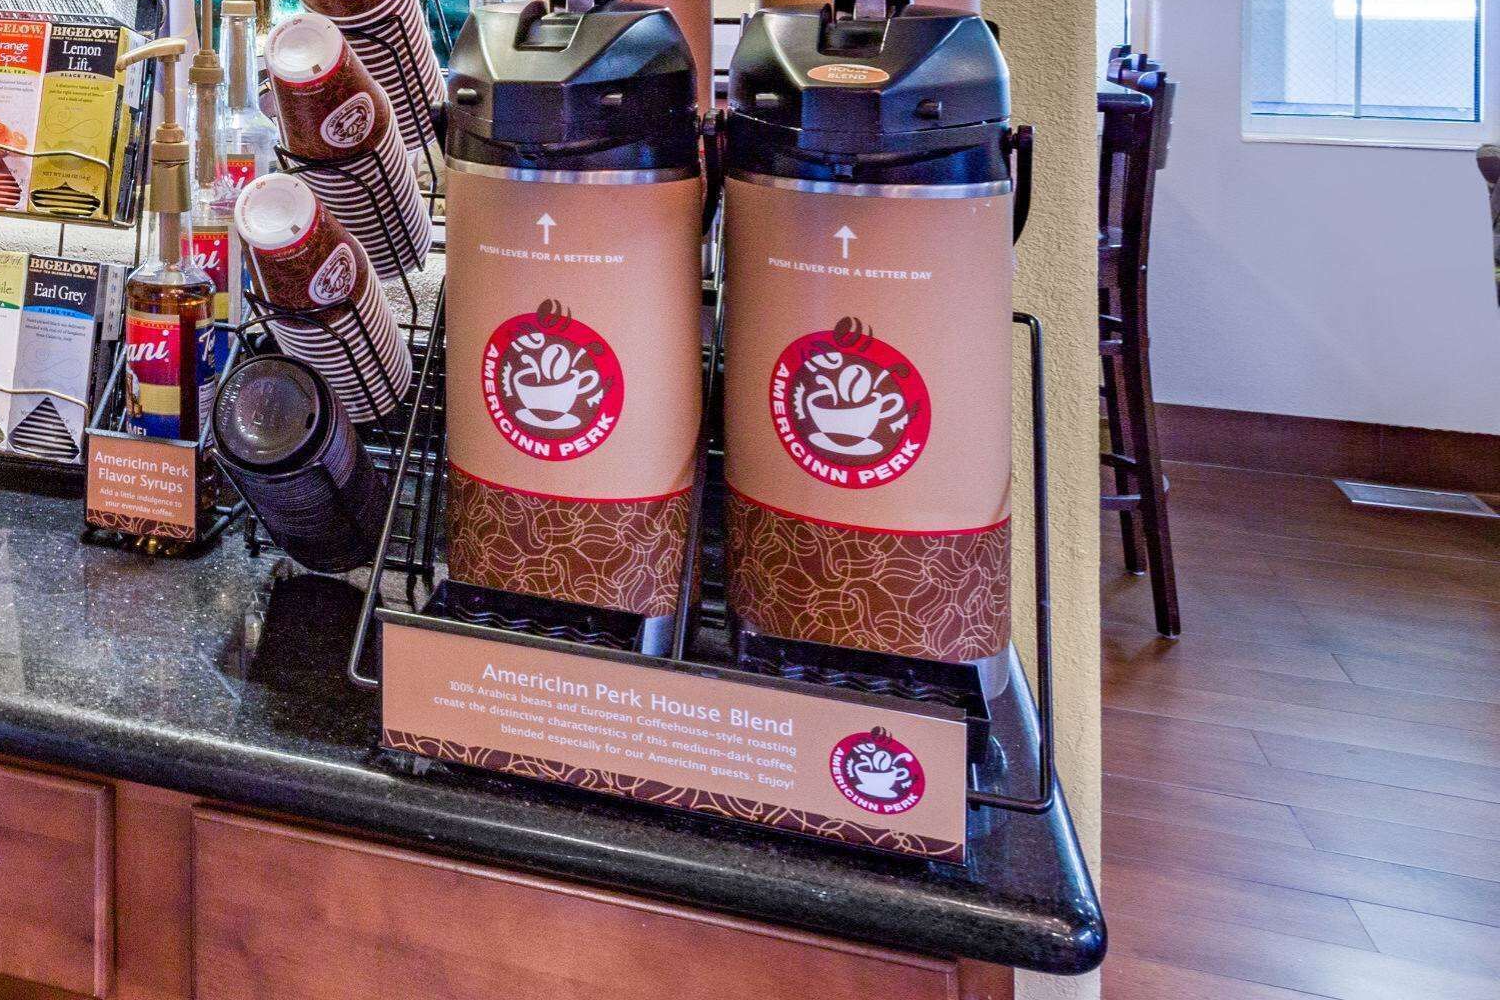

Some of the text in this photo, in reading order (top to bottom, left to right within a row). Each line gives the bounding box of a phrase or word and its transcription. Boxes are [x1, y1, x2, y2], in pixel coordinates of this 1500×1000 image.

[52, 26, 117, 39] BIGELOW
[0, 53, 27, 67] Spice
[62, 40, 102, 56] Lemon
[29, 258, 97, 277] BIGELOW
[501, 248, 528, 258] LEVER
[531, 251, 550, 261] FOR
[554, 253, 561, 261] A
[564, 254, 601, 262] BETTER
[768, 257, 932, 280] PUSH LEVER FOR A BETTER DAY
[33, 282, 87, 305] Earl Grey
[485, 343, 550, 456] AMERICINN
[558, 412, 615, 457] PERK
[772, 362, 849, 484] AMERICINN
[94, 450, 189, 478] AmericInn Perk
[857, 438, 921, 484] PERK
[98, 467, 183, 494] Flavor Syrups
[100, 488, 113, 496] Add
[120, 490, 136, 500] little
[137, 494, 174, 507] indulgence
[122, 502, 151, 514] everyday
[482, 663, 793, 736] AmericInn Perk House Blend
[449, 680, 797, 758] 100% Arabica beans and European Coffeehouse-style roasting
[434, 696, 797, 773] create the distinctive characteristics of this medium-dark coffee.
[501, 724, 795, 791] blended especially for our AmericInn guests. Enjoy!
[832, 747, 879, 811] AMERICINN
[883, 793, 919, 812] PERK
